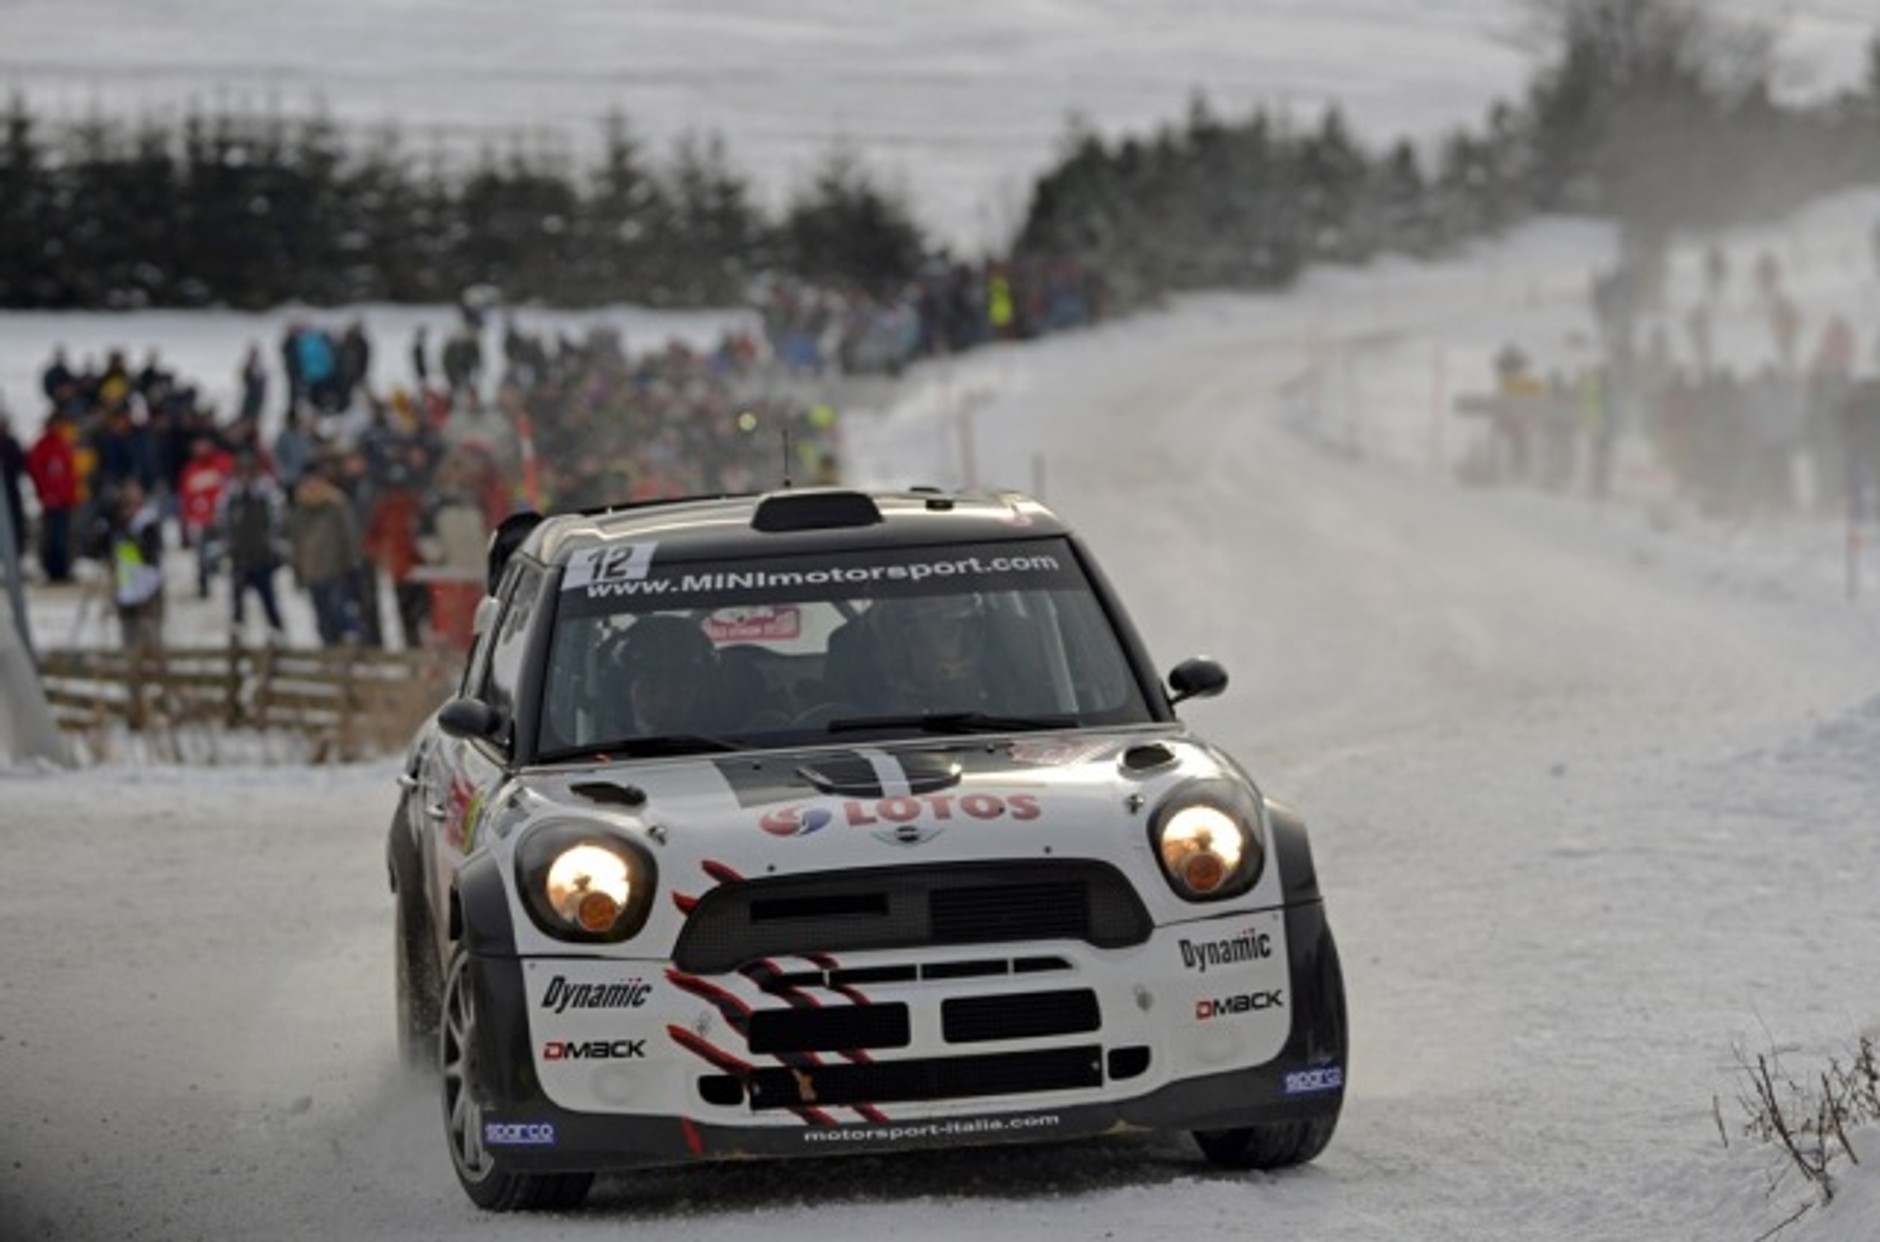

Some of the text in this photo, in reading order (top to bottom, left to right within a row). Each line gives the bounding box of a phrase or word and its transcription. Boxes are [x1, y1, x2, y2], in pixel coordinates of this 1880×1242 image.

[587, 555, 1060, 598] www.MINImotorsport.com
[588, 546, 633, 579] 12
[843, 794, 1042, 826] LOTOS
[1179, 928, 1271, 972] Dynamic
[542, 975, 653, 1013] Dynamic
[1196, 990, 1283, 1019] DMACK
[544, 1040, 646, 1060] DMACK
[805, 1115, 1059, 1141] motorsport-italia.com
